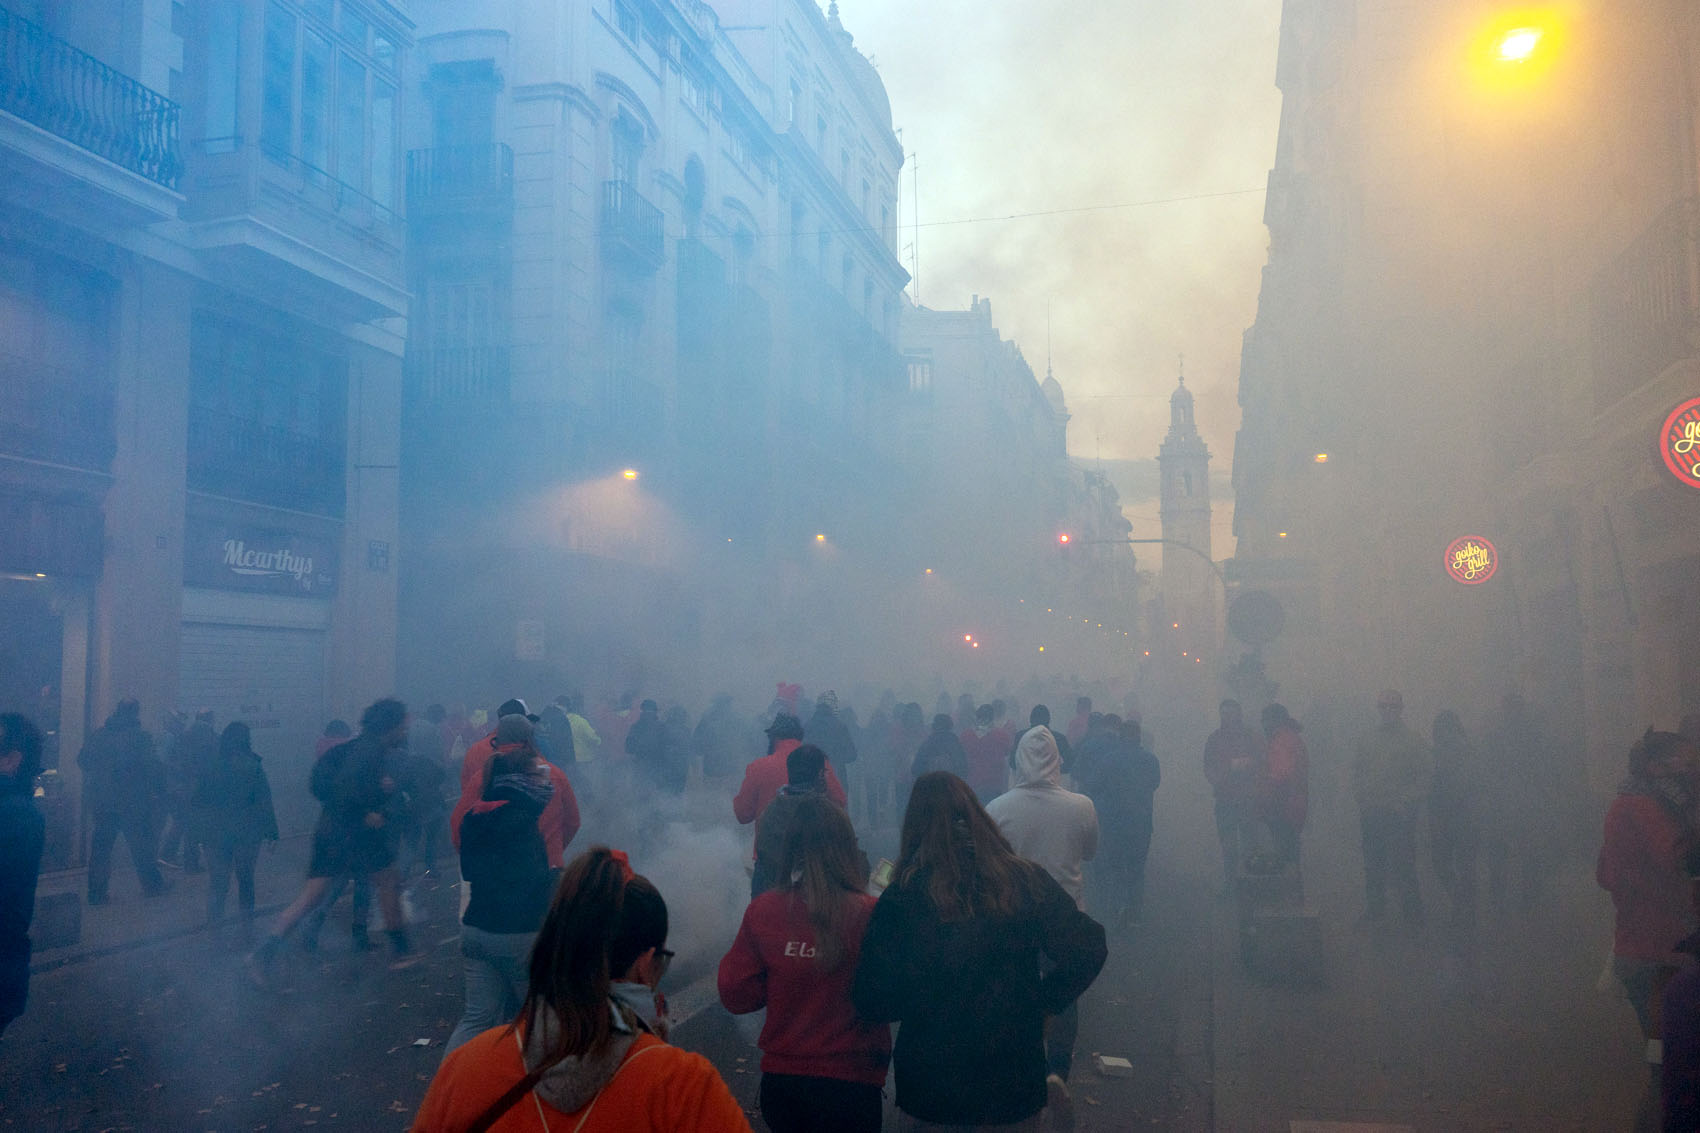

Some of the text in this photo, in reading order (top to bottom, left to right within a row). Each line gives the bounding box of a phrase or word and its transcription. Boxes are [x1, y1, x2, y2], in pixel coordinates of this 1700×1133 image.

[223, 539, 313, 580] Mcarthys
[1453, 542, 1480, 569] goiko
[1465, 548, 1489, 580] grill
